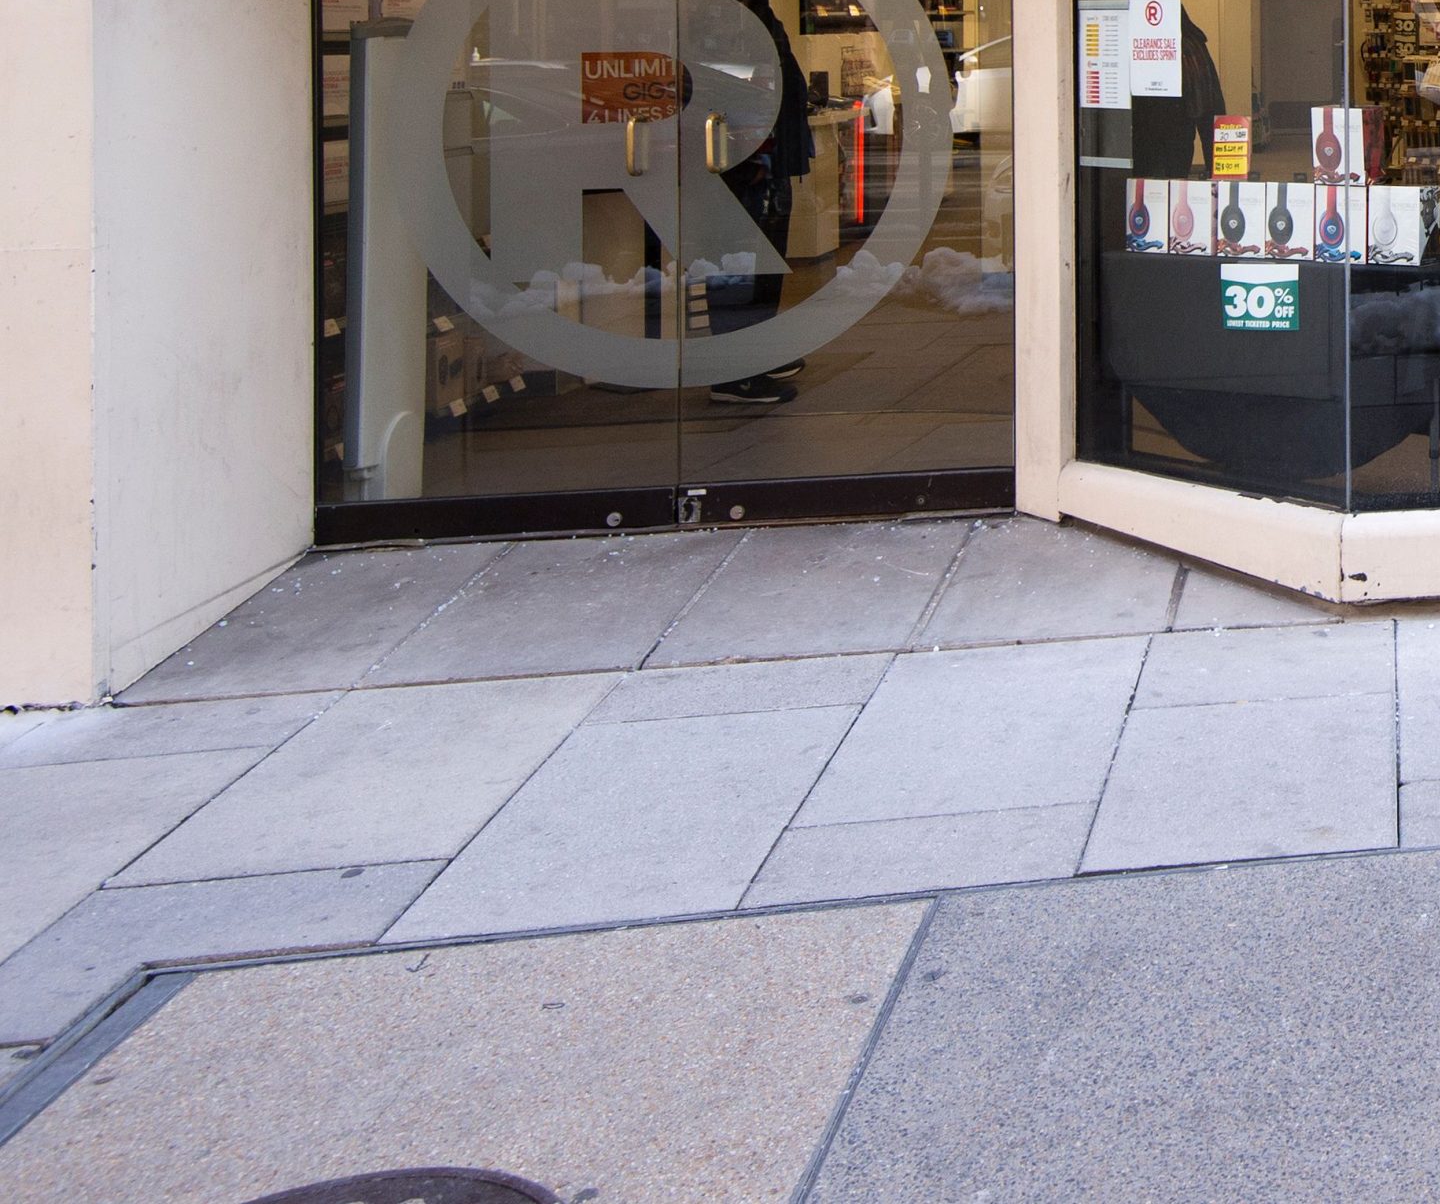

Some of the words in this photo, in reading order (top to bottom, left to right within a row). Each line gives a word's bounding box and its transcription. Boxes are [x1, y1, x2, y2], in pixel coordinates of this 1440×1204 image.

[1133, 39, 1163, 49] CLEARANCE
[1164, 39, 1176, 49] SALE
[1133, 50, 1159, 60] EXCLUDES
[1224, 285, 1294, 318] 30%
[1274, 305, 1295, 318] OFF
